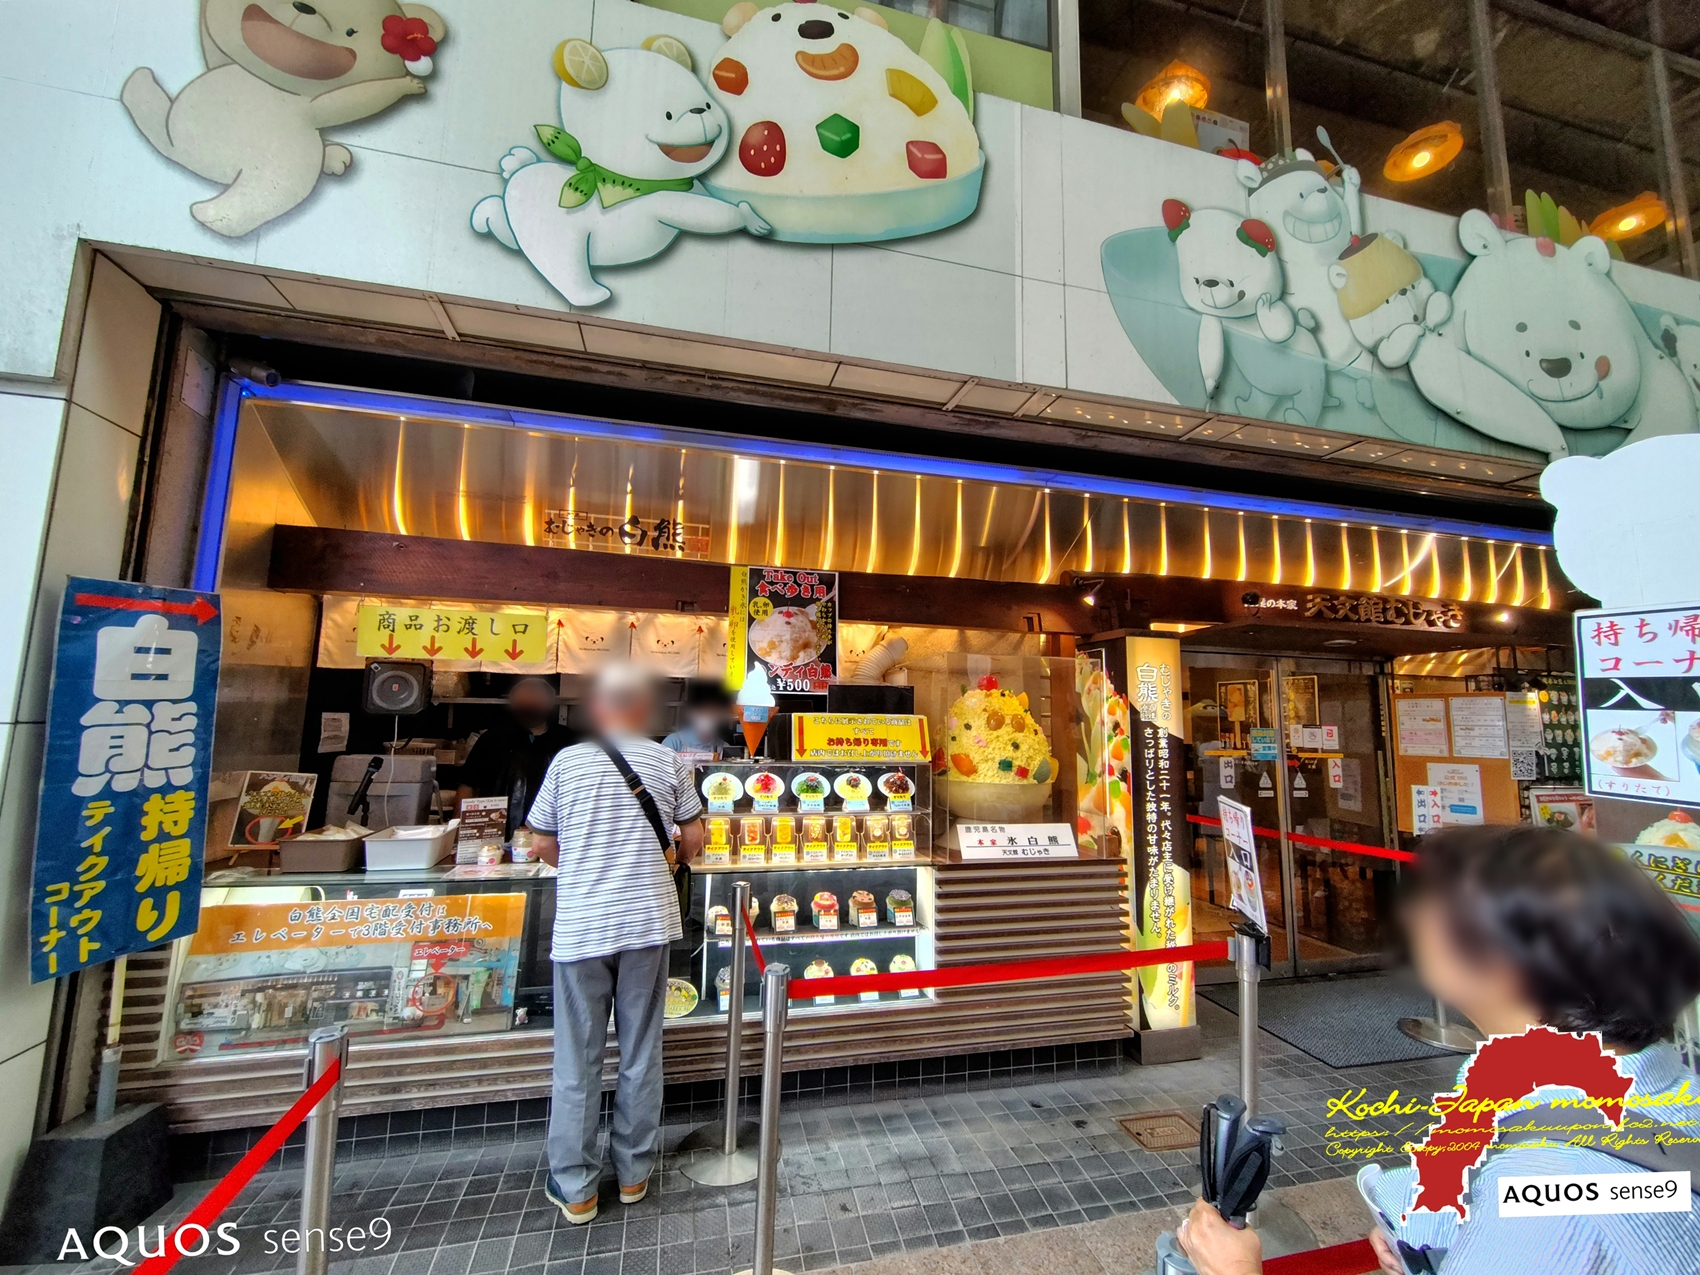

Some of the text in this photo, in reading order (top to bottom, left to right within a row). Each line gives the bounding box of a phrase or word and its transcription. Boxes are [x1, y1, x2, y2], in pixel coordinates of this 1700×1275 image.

[544, 515, 685, 551] むじゃきの白熊
[763, 569, 819, 584] Take Out
[756, 580, 826, 598] 食べ歩き用
[1304, 593, 1464, 629] 天文館むじゃき
[377, 611, 529, 636] 商品お渡し口
[762, 660, 832, 680] ンディ白熊
[776, 678, 811, 692] ¥500
[1136, 663, 1159, 703] 白熊
[1160, 663, 1172, 721] むじゃきの
[71, 614, 199, 797] 白熊
[827, 737, 901, 747] お持ち帰り専用です
[853, 727, 874, 735] すべて
[1224, 760, 1233, 784] 出口
[1332, 761, 1341, 783] 入口
[1417, 799, 1427, 823] 出口
[1431, 799, 1441, 823] 入口
[1007, 836, 1059, 846] 氷白熊
[1229, 840, 1250, 868] 入口
[135, 791, 195, 942] 持帰り
[1157, 727, 1180, 1010] 創業昭和二十一年。代々店主に受け継がれた秘のミルク。
[70, 800, 115, 963] テイクアウト
[288, 902, 447, 925] 白熊全国宅配受付は
[40, 881, 70, 974] コーナー
[229, 916, 493, 944] エレベーターで3階受付事務所へ
[414, 945, 466, 957] エレベーター
